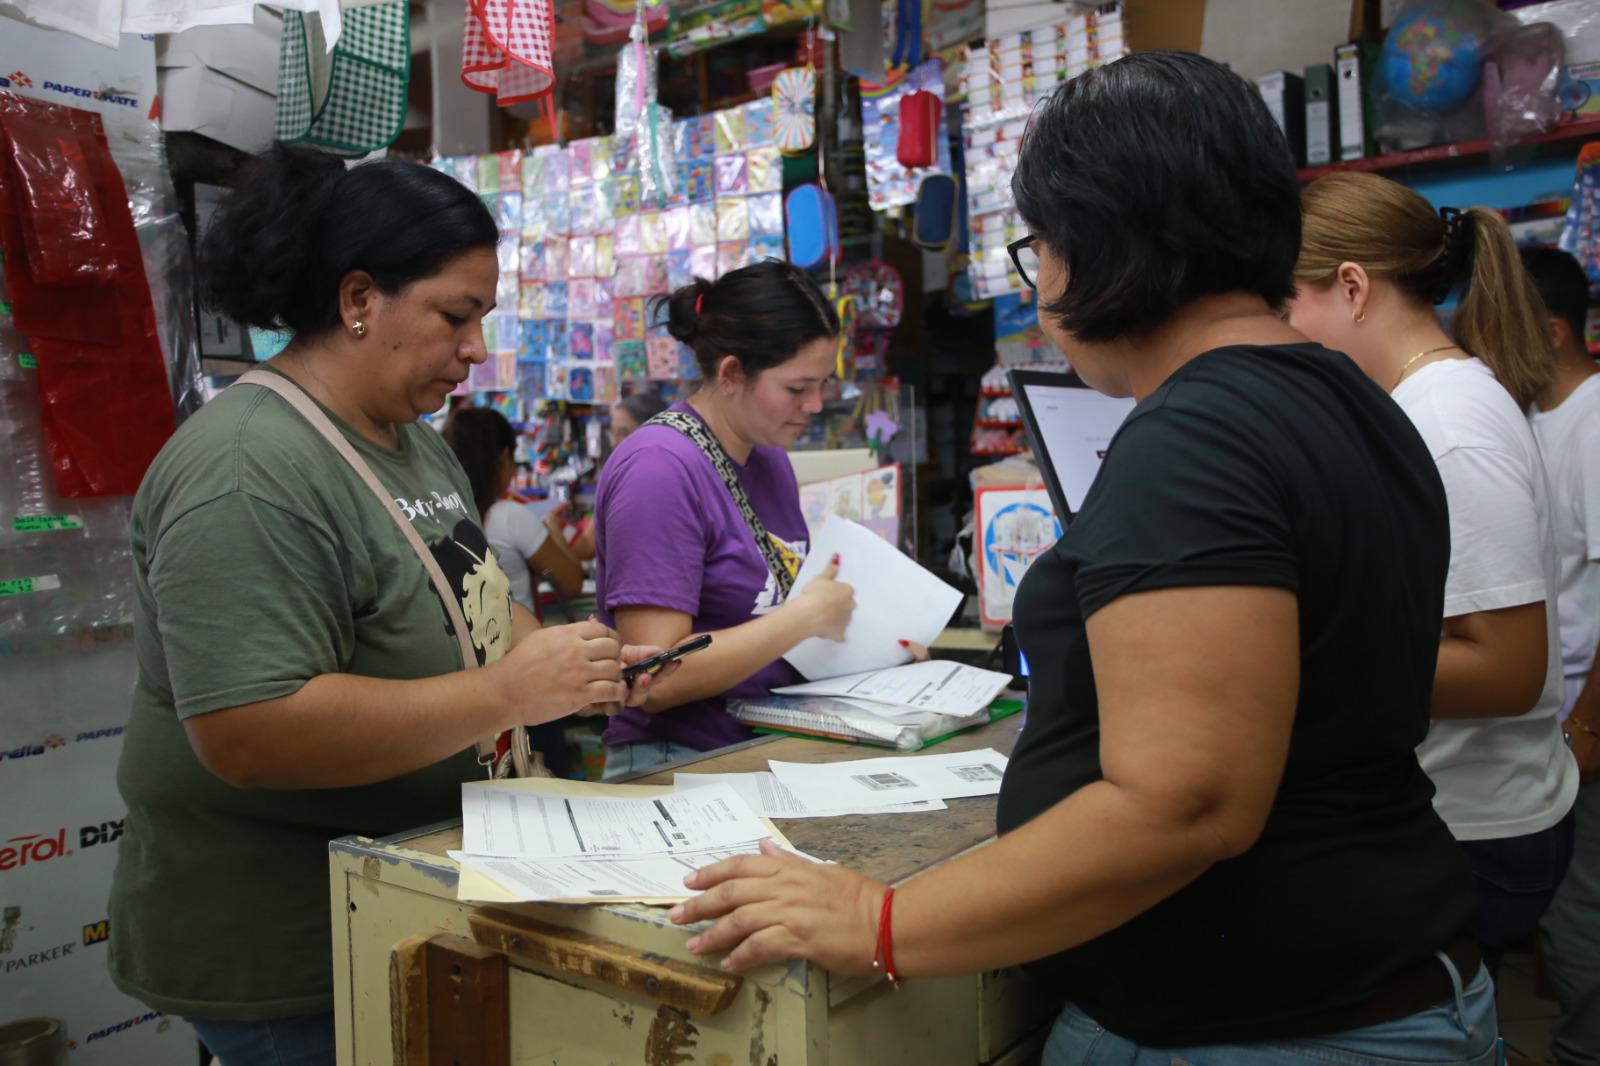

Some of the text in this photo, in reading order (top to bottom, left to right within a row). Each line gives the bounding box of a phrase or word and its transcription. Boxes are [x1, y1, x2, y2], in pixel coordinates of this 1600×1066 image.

[43, 81, 91, 97] PAPER
[6, 943, 72, 973] PARKER
[86, 1021, 134, 1044] PAPER
